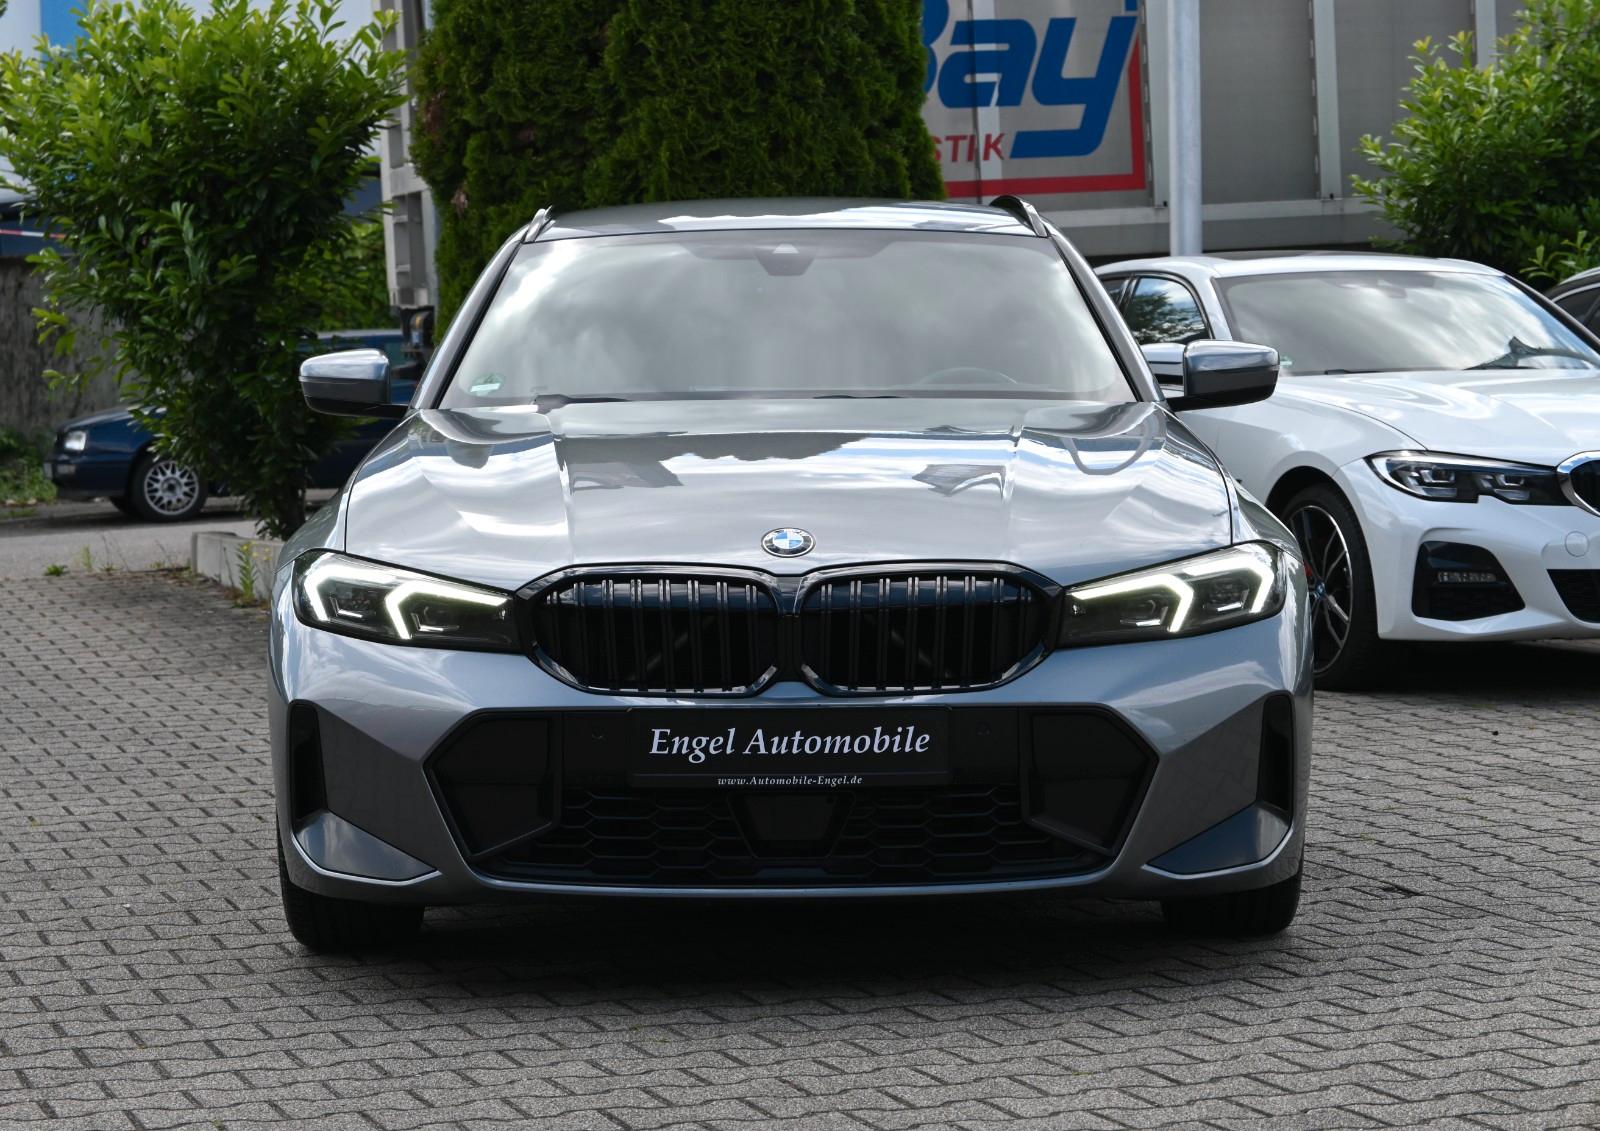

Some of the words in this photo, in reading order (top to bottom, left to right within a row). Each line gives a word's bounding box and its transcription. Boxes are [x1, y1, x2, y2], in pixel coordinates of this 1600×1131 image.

[649, 727, 736, 764] Engel
[742, 725, 931, 755] Automobile
[717, 775, 863, 788] www.Automobile-Engel.de
